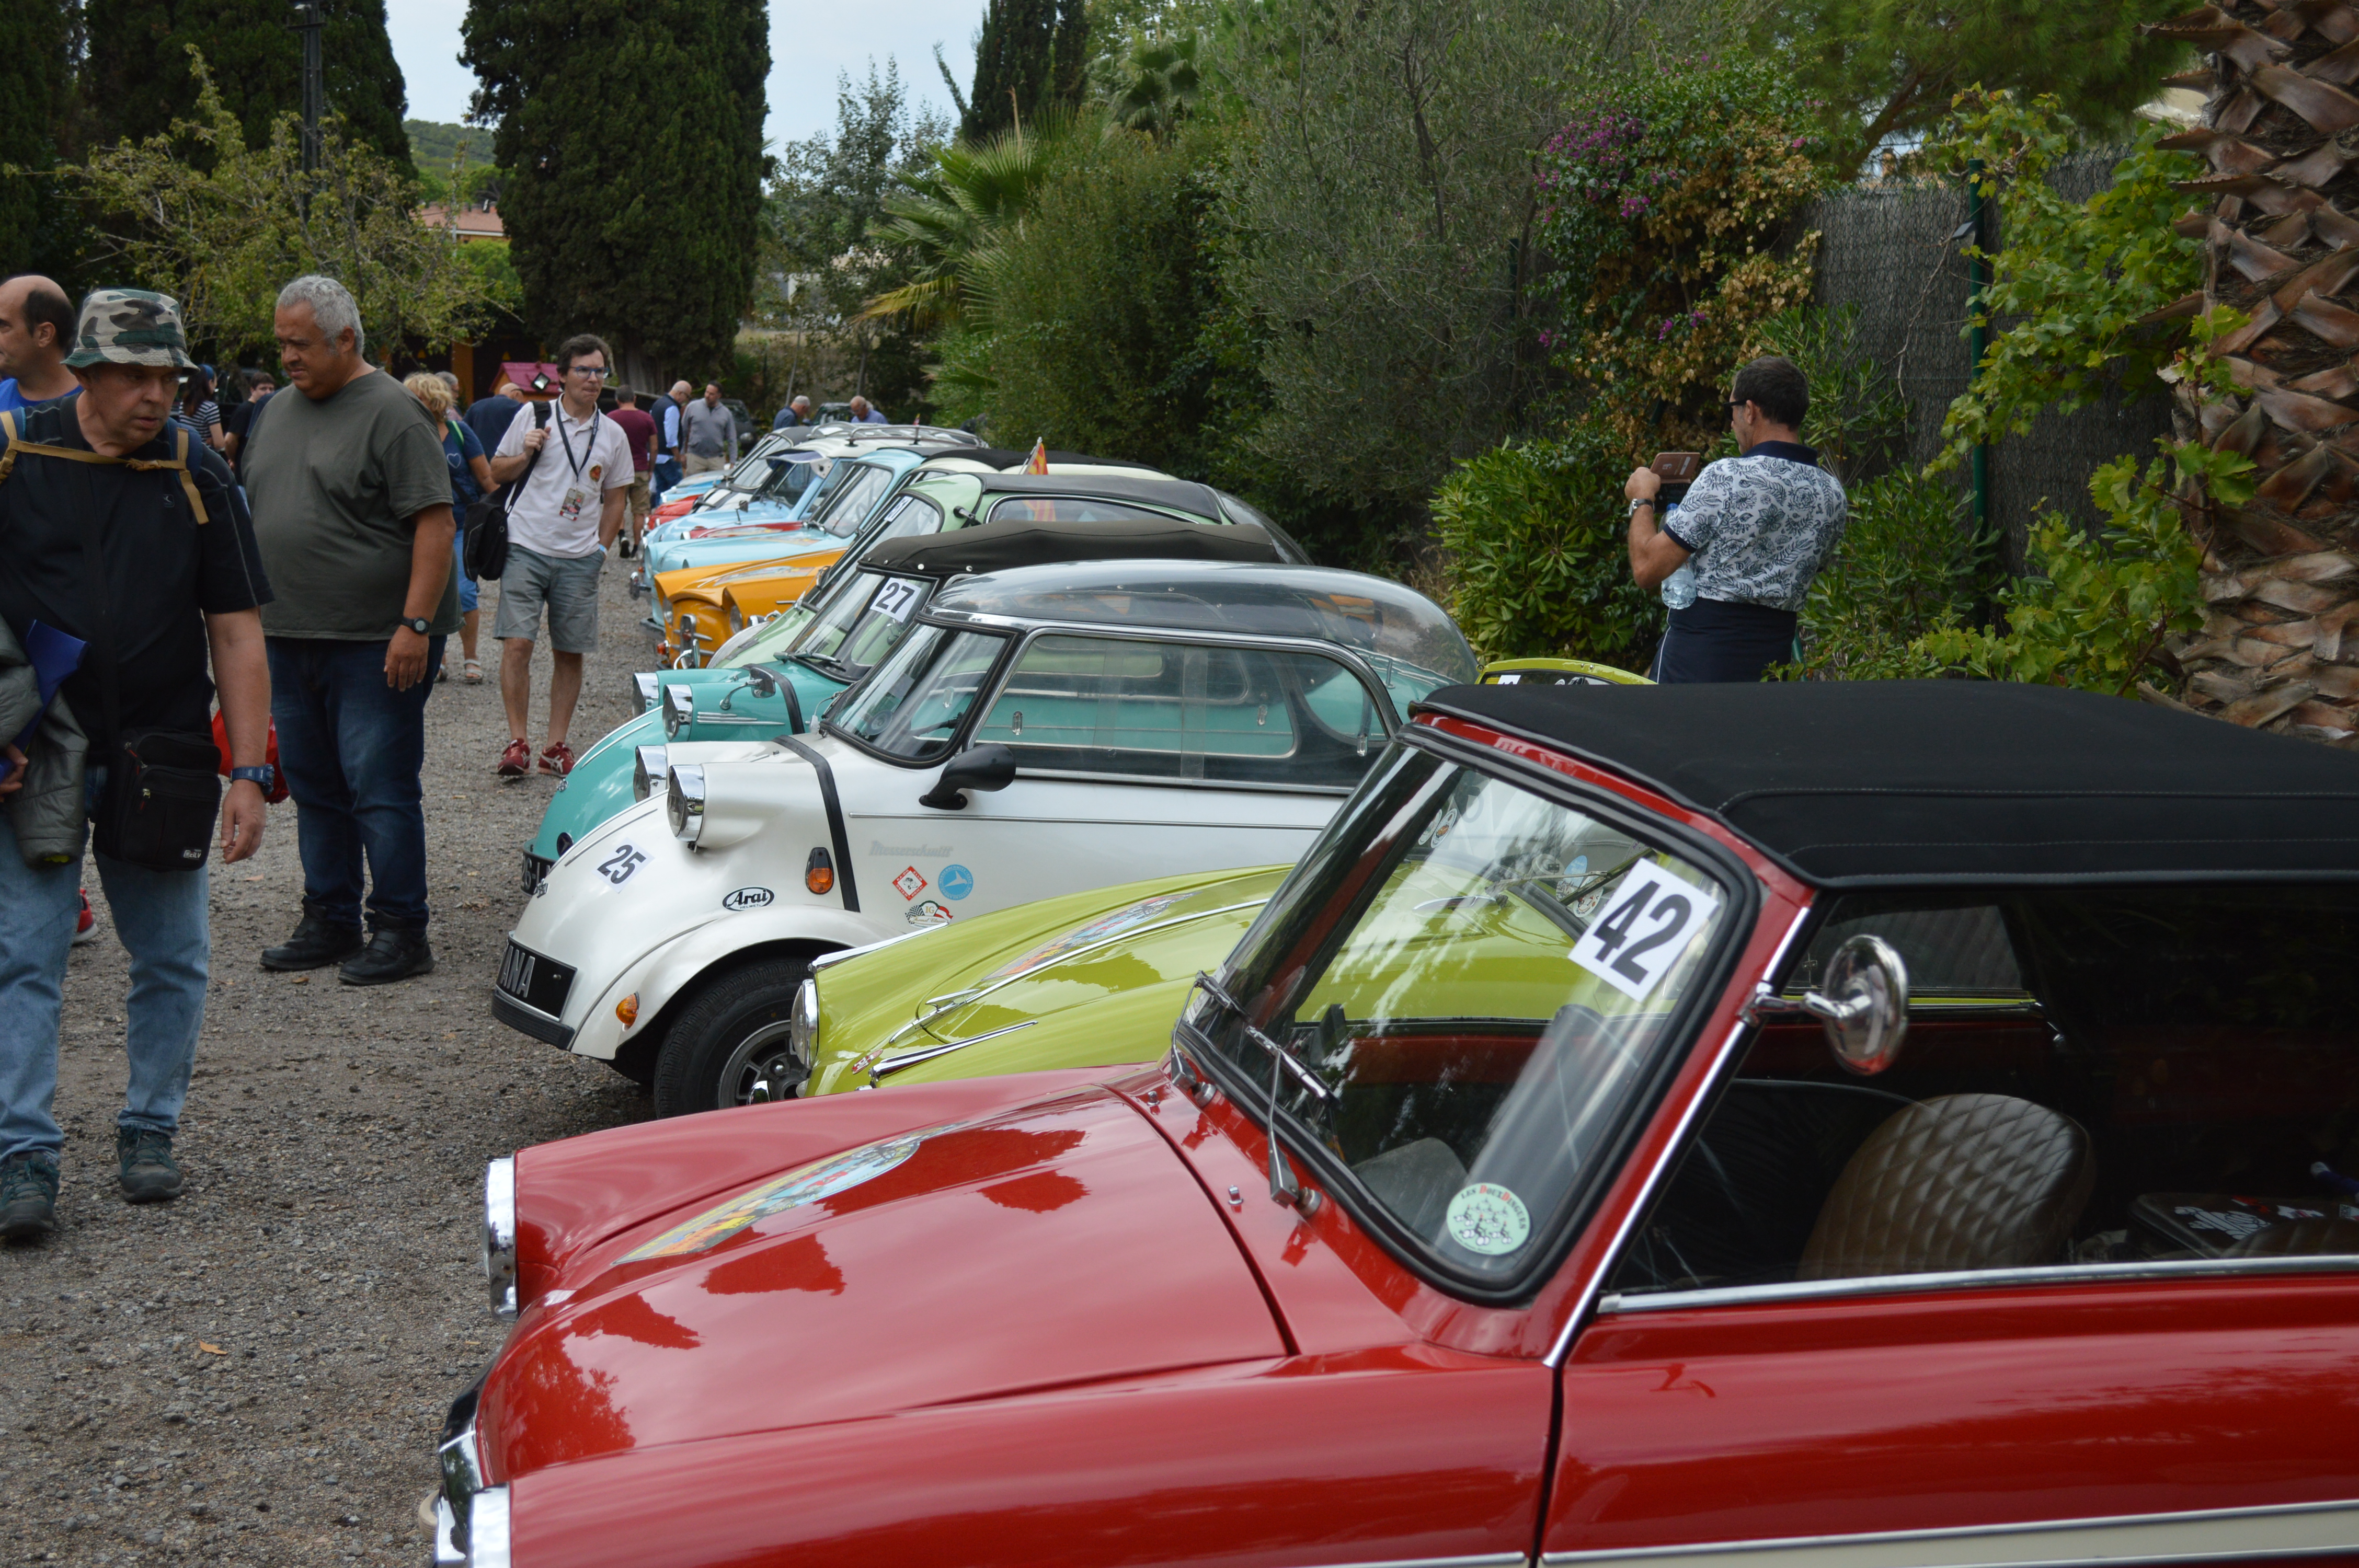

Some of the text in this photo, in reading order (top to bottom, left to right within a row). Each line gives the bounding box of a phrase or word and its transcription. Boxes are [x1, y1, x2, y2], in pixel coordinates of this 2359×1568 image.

[876, 582, 915, 614] 27
[597, 844, 647, 884] 25
[913, 871, 923, 882] CLUB
[726, 889, 769, 907] Arai
[1593, 880, 1692, 985] 42
[500, 945, 535, 998] ANA
[1461, 1188, 1476, 1200] LES
